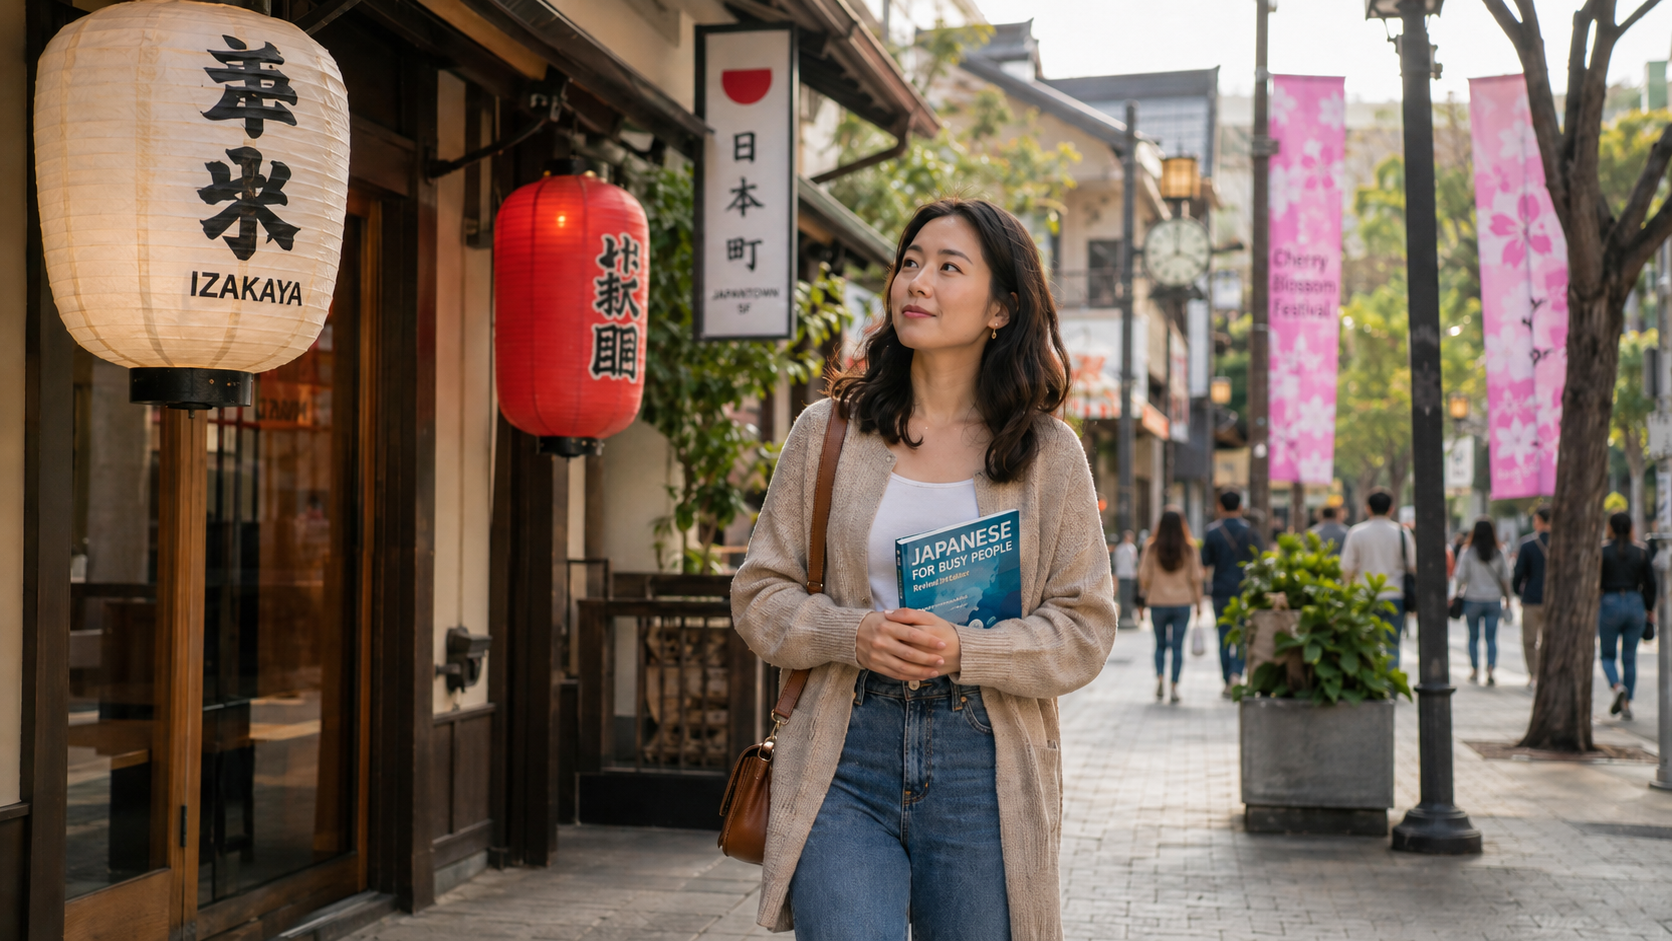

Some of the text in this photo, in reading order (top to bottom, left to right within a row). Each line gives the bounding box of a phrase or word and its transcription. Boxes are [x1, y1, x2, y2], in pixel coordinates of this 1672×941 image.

[726, 131, 765, 271] 日本町
[1273, 247, 1328, 274] Cherry
[190, 270, 303, 307] IZAKAYA
[1273, 273, 1336, 294] Blossom
[1273, 298, 1331, 318] Festival
[912, 520, 1012, 566] JAPANESE
[912, 565, 935, 580] FOR
[939, 555, 967, 573] BUSY
[971, 541, 1012, 563] PEOPLE
